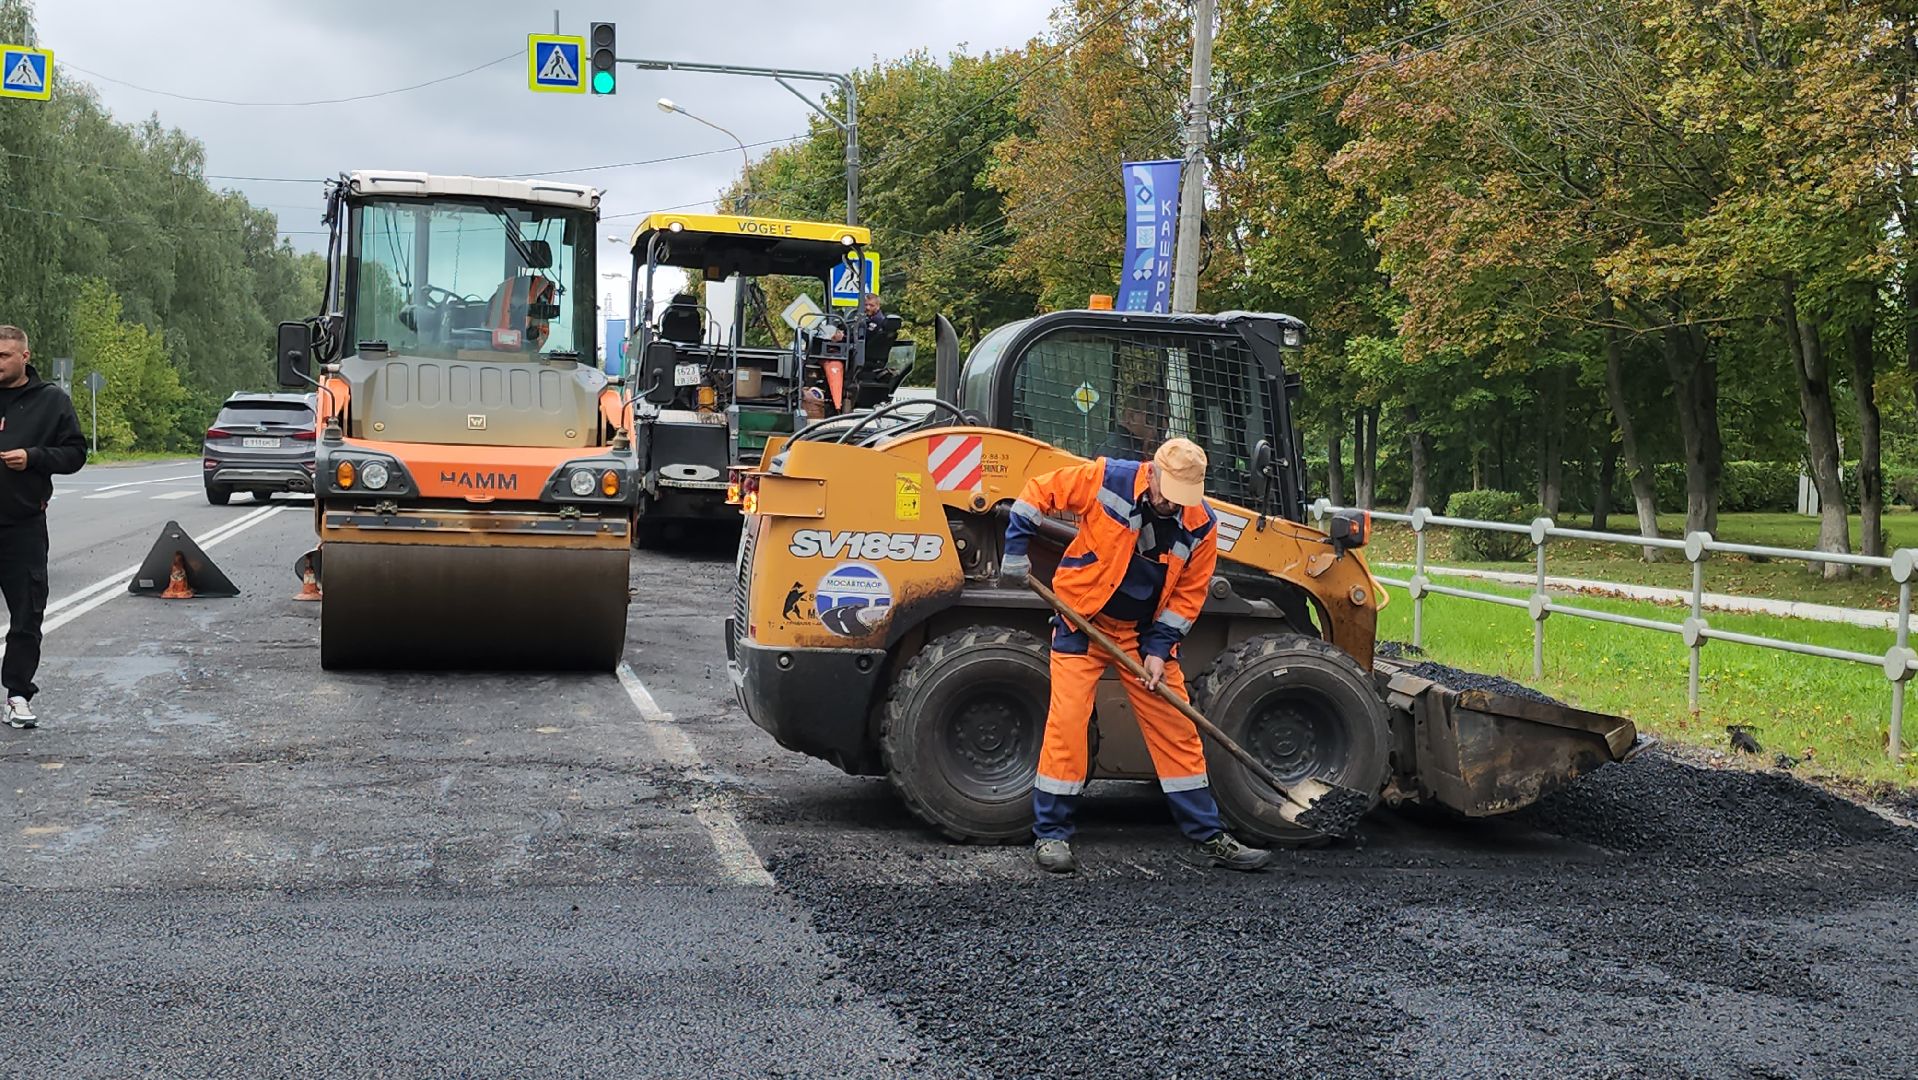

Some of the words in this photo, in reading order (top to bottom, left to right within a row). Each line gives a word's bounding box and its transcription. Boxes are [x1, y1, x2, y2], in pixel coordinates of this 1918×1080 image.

[1152, 200, 1172, 313] КАШИРА
[440, 471, 517, 490] HAMM
[789, 529, 944, 561] SV185B
